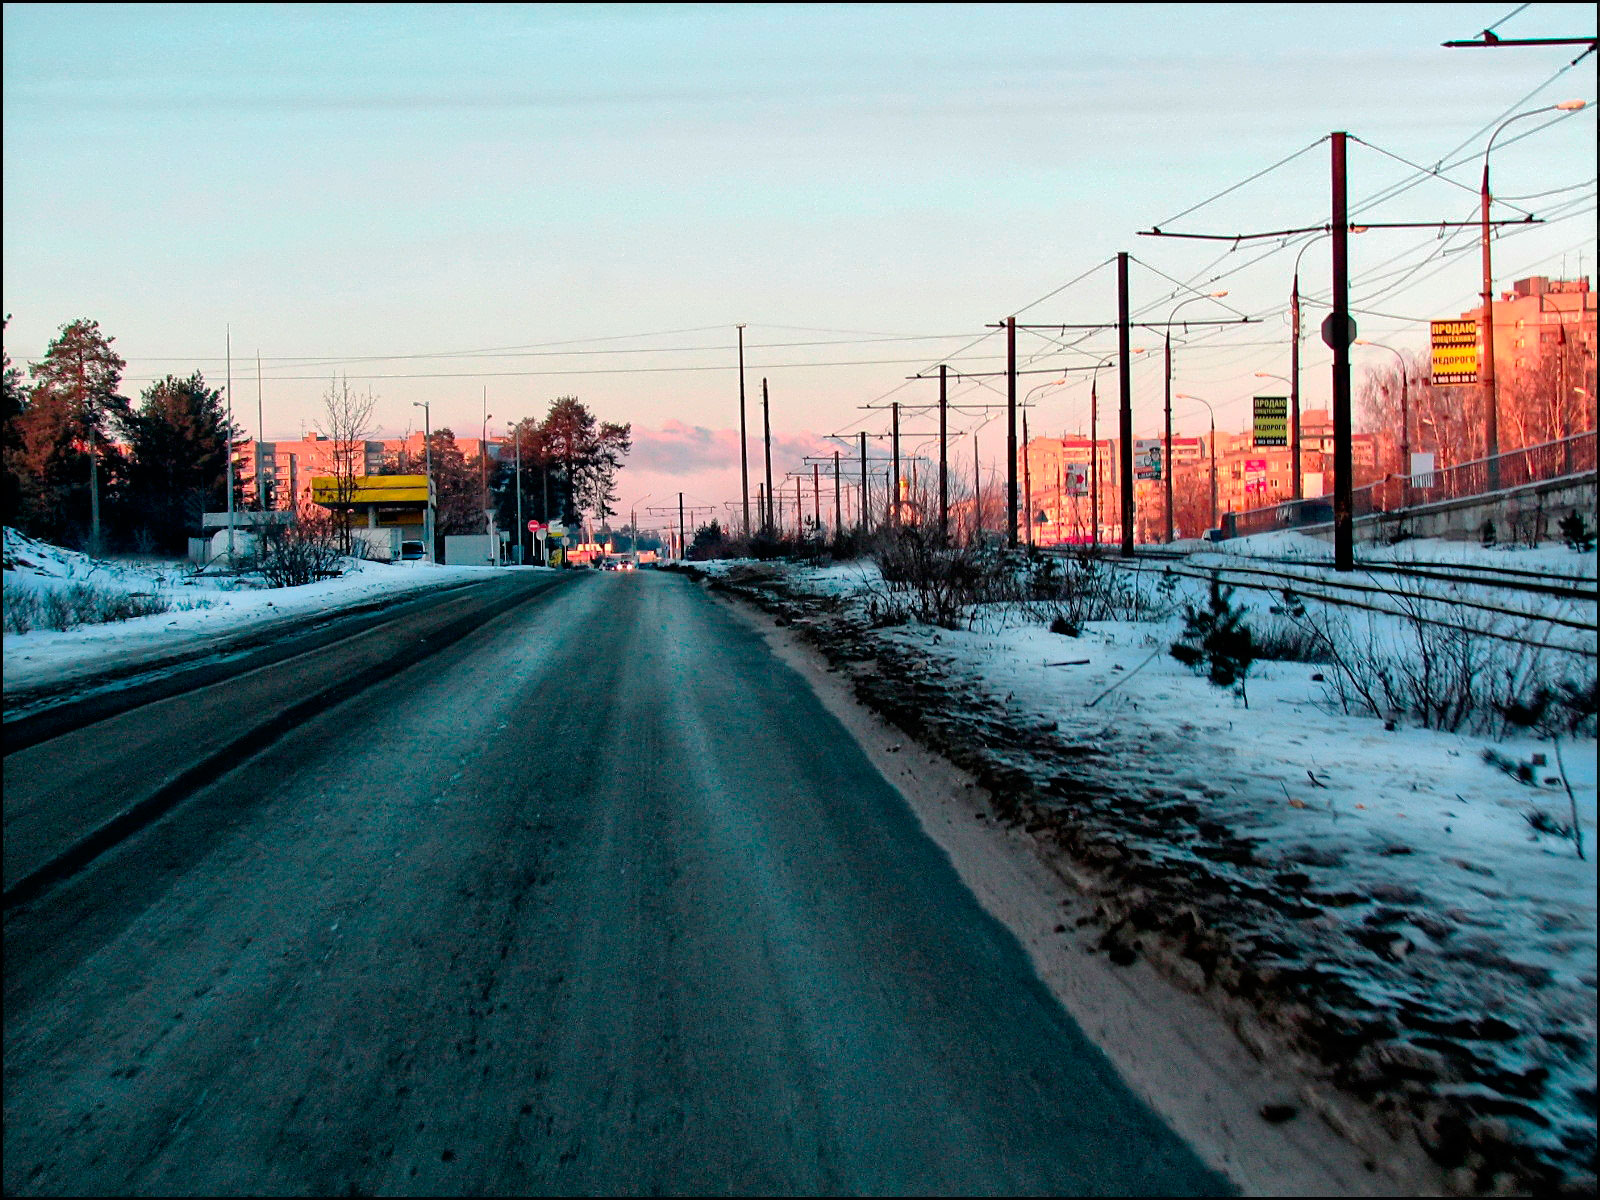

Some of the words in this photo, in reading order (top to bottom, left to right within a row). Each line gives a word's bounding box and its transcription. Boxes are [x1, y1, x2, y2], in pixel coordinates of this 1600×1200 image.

[1432, 323, 1475, 335] ПРОДАЮ
[1432, 335, 1475, 343] СПЕЦТЕХНИКУ
[1433, 356, 1475, 365] НЕДОРОГО
[1255, 399, 1286, 408] ПРОДАЮ
